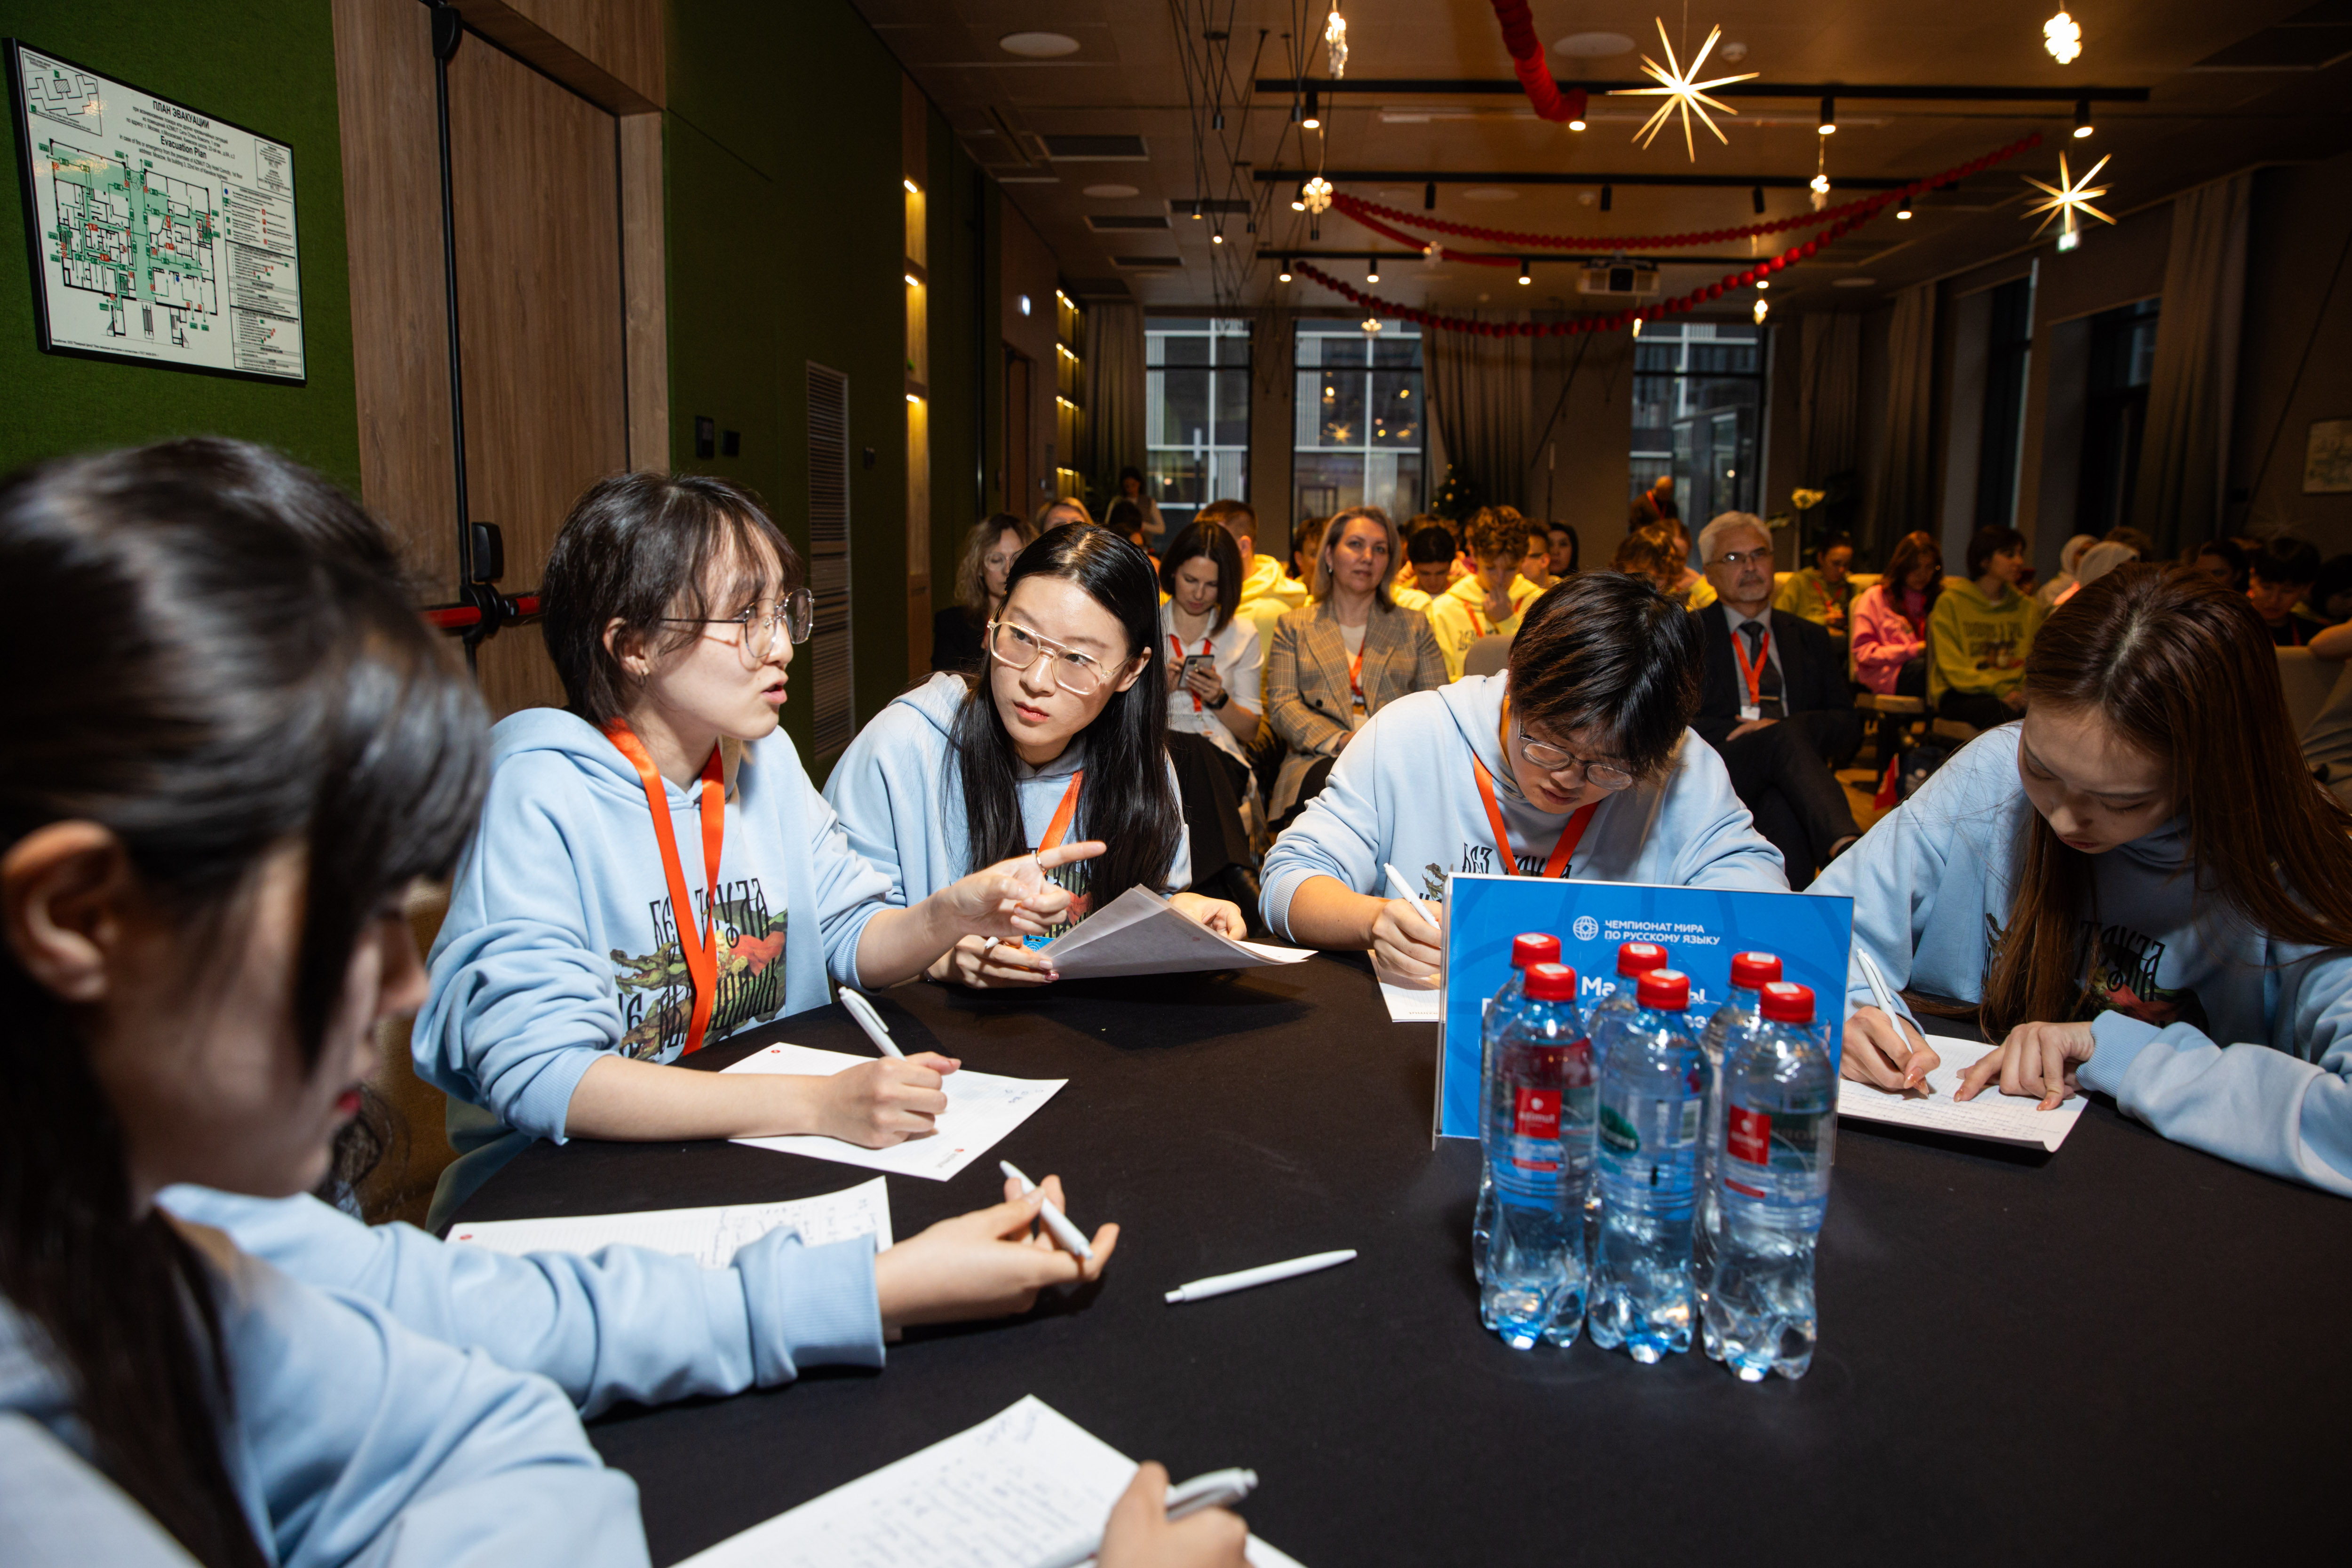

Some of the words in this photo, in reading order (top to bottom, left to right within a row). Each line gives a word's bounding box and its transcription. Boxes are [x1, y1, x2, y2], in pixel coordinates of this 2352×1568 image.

[153, 101, 171, 115] ПЛАН
[172, 108, 209, 130] ЭВАКУАЦИИ
[166, 124, 178, 133] AZIMUT
[146, 143, 162, 152] emergency
[176, 152, 189, 161] premises
[161, 136, 192, 154] Evacuation
[194, 147, 206, 159] Plan
[1605, 920, 1672, 931] ЧЕМПИОНАТ
[1674, 924, 1705, 933] МИРА
[1605, 930, 1621, 940] ПО
[1624, 931, 1681, 943] РУССКОМУ
[1683, 935, 1720, 945] ЯЗЫКУ
